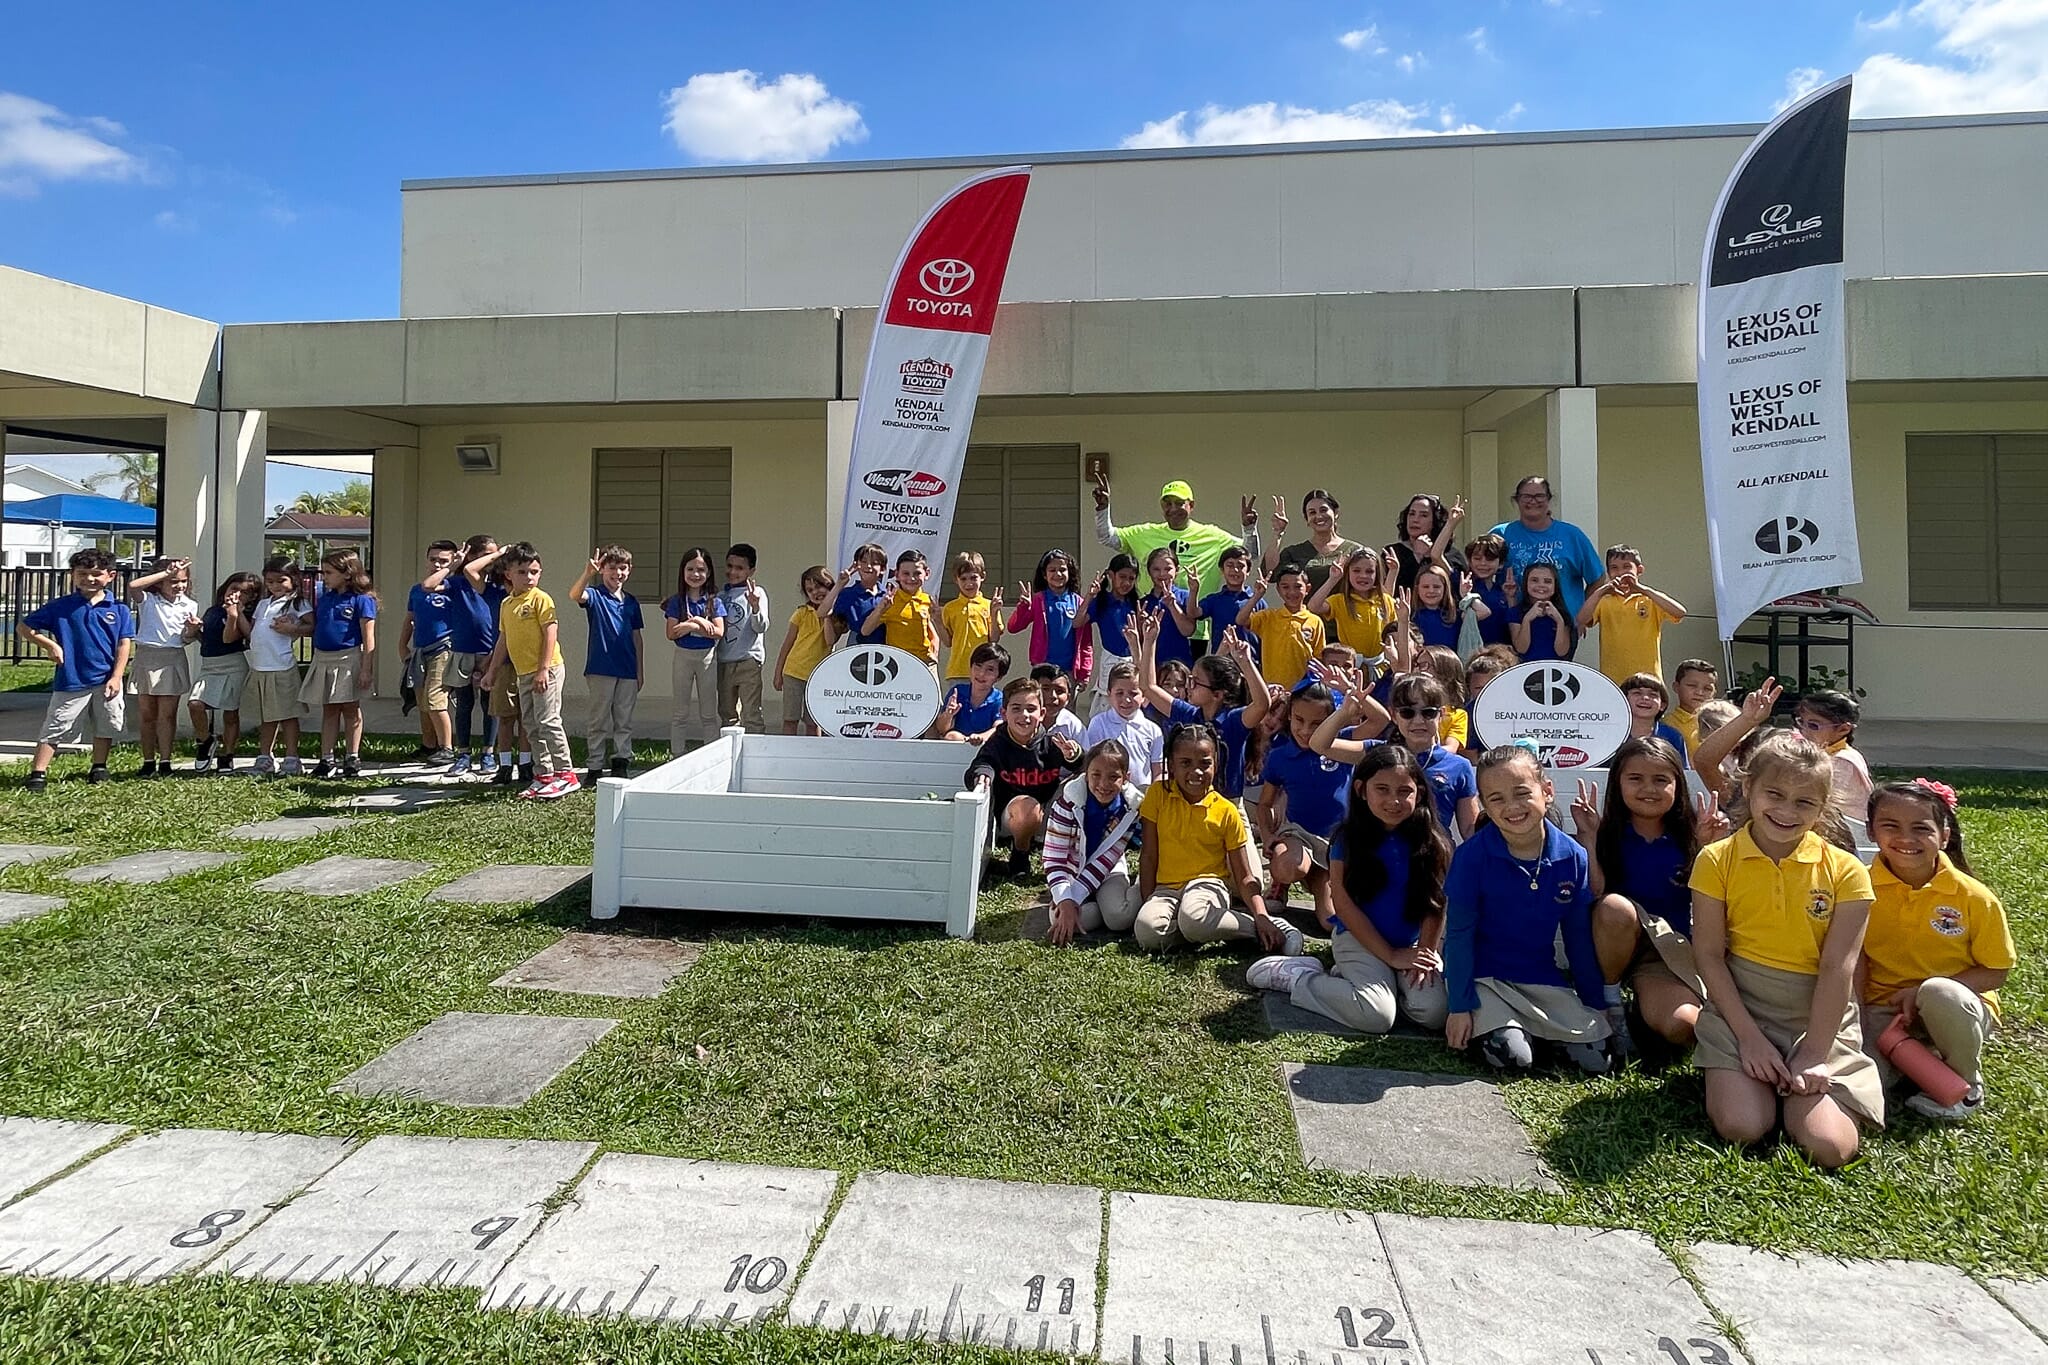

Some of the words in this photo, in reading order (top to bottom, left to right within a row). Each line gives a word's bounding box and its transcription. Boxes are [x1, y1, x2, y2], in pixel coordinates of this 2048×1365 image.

[1729, 215, 1823, 248] LEXUS
[1782, 231, 1822, 246] AMAZING
[907, 298, 973, 317] TOYOTA
[1727, 308, 1790, 333] LEXUS
[1796, 303, 1822, 319] OF
[1727, 320, 1819, 349] KENDALL
[902, 363, 951, 377] KENDALL
[906, 376, 943, 388] TOYOTA
[1729, 383, 1793, 406] LEXUS
[1798, 380, 1822, 395] OF
[894, 398, 945, 412] KENDALL
[1731, 401, 1784, 420] WEST
[896, 409, 939, 422] TOYOTA
[882, 420, 950, 433] KENDALLTOYOTA.COM
[1732, 412, 1820, 436] KENDALL
[1737, 477, 1758, 488] ALL
[1761, 475, 1776, 486] AT
[1778, 469, 1829, 484] KENDALL
[860, 499, 891, 513] WEST
[892, 502, 940, 517] KENDALL
[878, 512, 920, 526] TOYOTA
[855, 522, 938, 536] WESTKENDALLTOYOTA.COM
[1763, 556, 1808, 567] AUTOMOTIVE
[823, 689, 844, 697] BEAN
[845, 690, 894, 699] AUTOMOTIVE
[895, 692, 922, 701] GROUP
[1494, 712, 1518, 720] BEAN
[1521, 712, 1577, 721] AUTOMOTIVE
[1578, 712, 1609, 721] GROUP
[170, 1209, 246, 1248] 8
[471, 1216, 519, 1250] 9
[724, 1254, 787, 1294] 10
[1023, 1275, 1074, 1314] 11
[1334, 1306, 1409, 1349] 12
